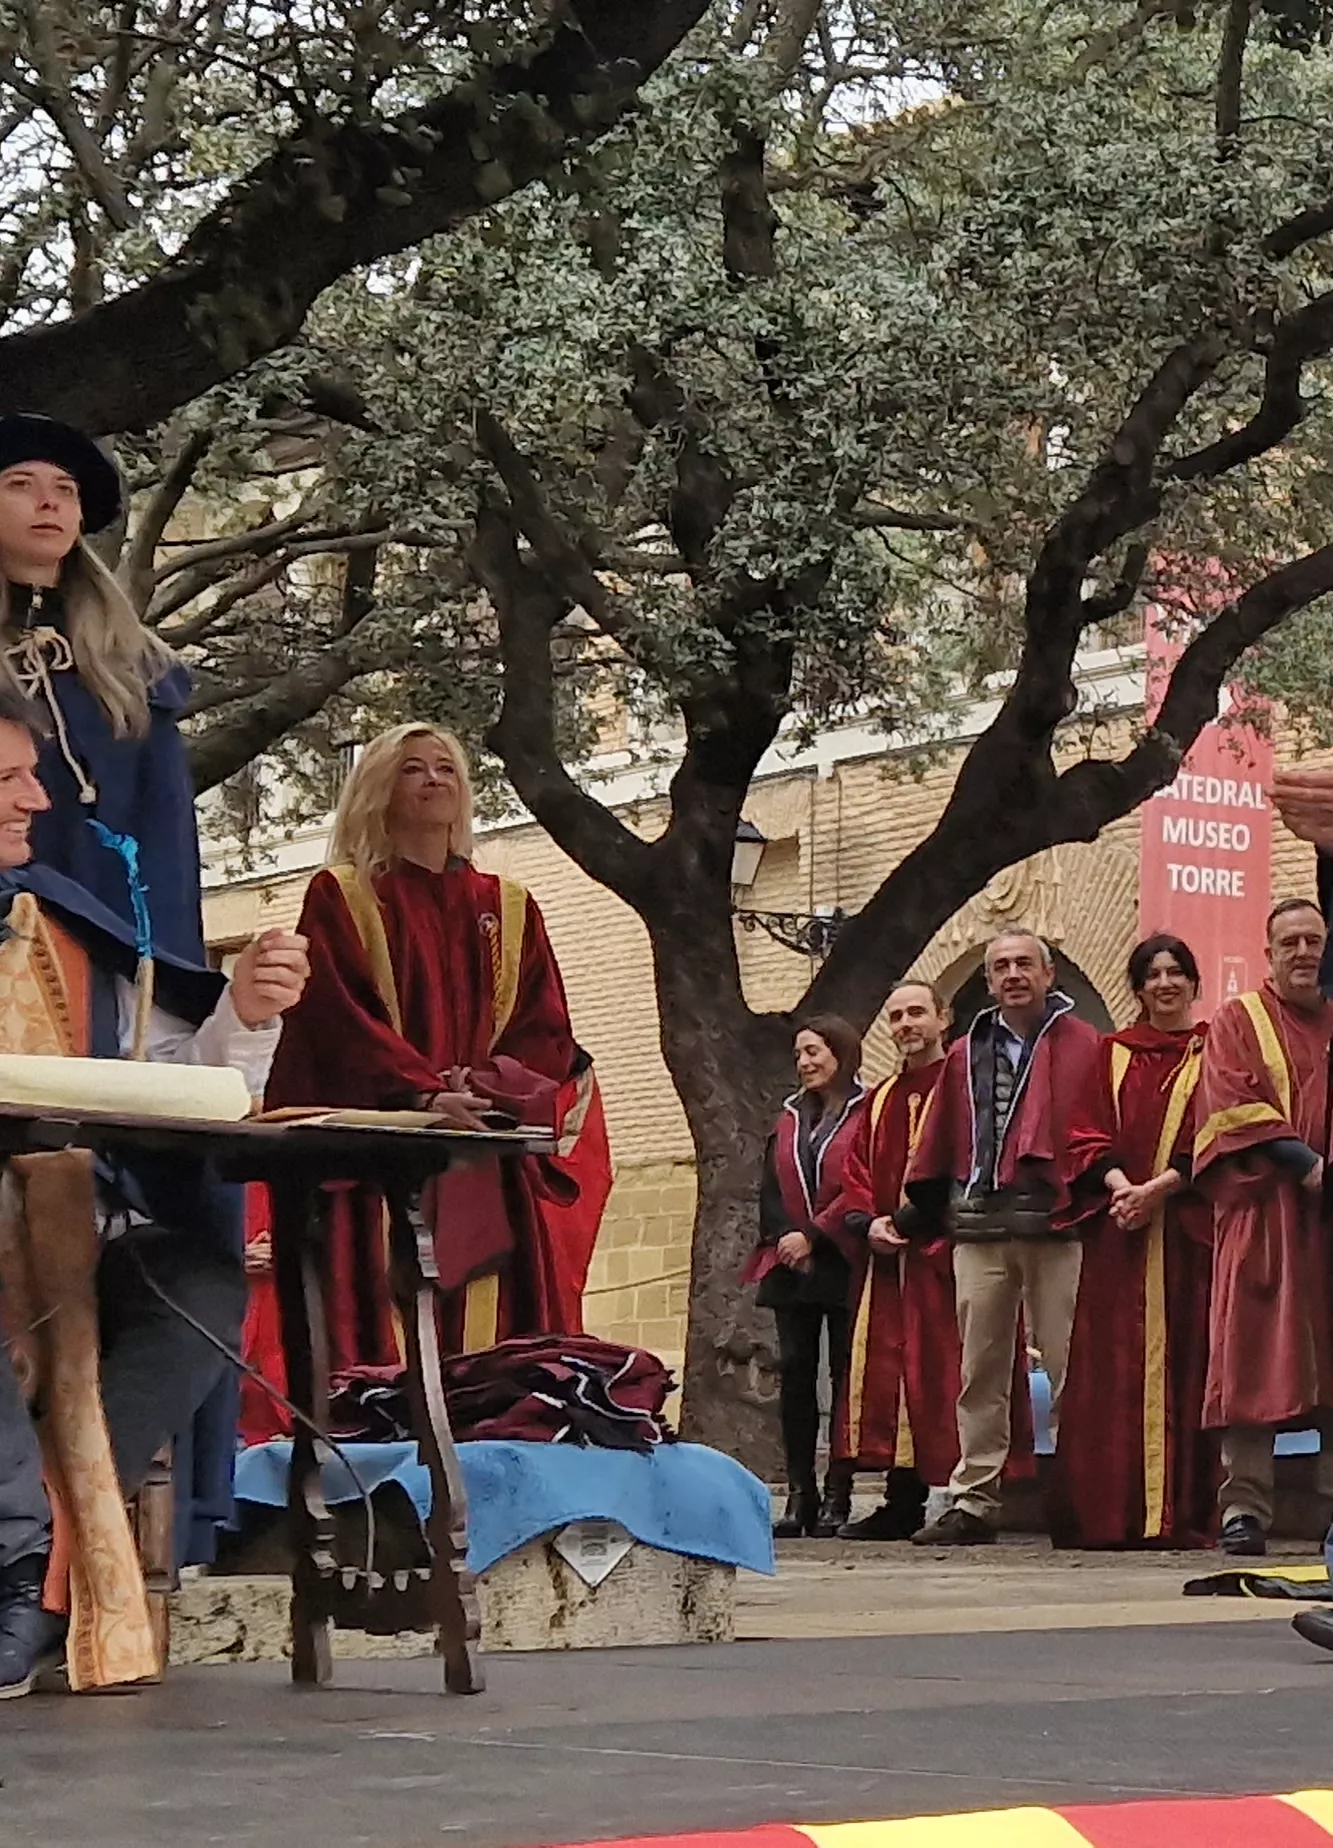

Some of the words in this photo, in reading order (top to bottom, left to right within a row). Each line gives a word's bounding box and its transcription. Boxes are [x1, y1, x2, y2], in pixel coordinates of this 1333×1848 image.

[1153, 772, 1267, 810] ATEDRAL
[1162, 815, 1250, 852] MUSEO
[1167, 863, 1245, 897] TORRE
